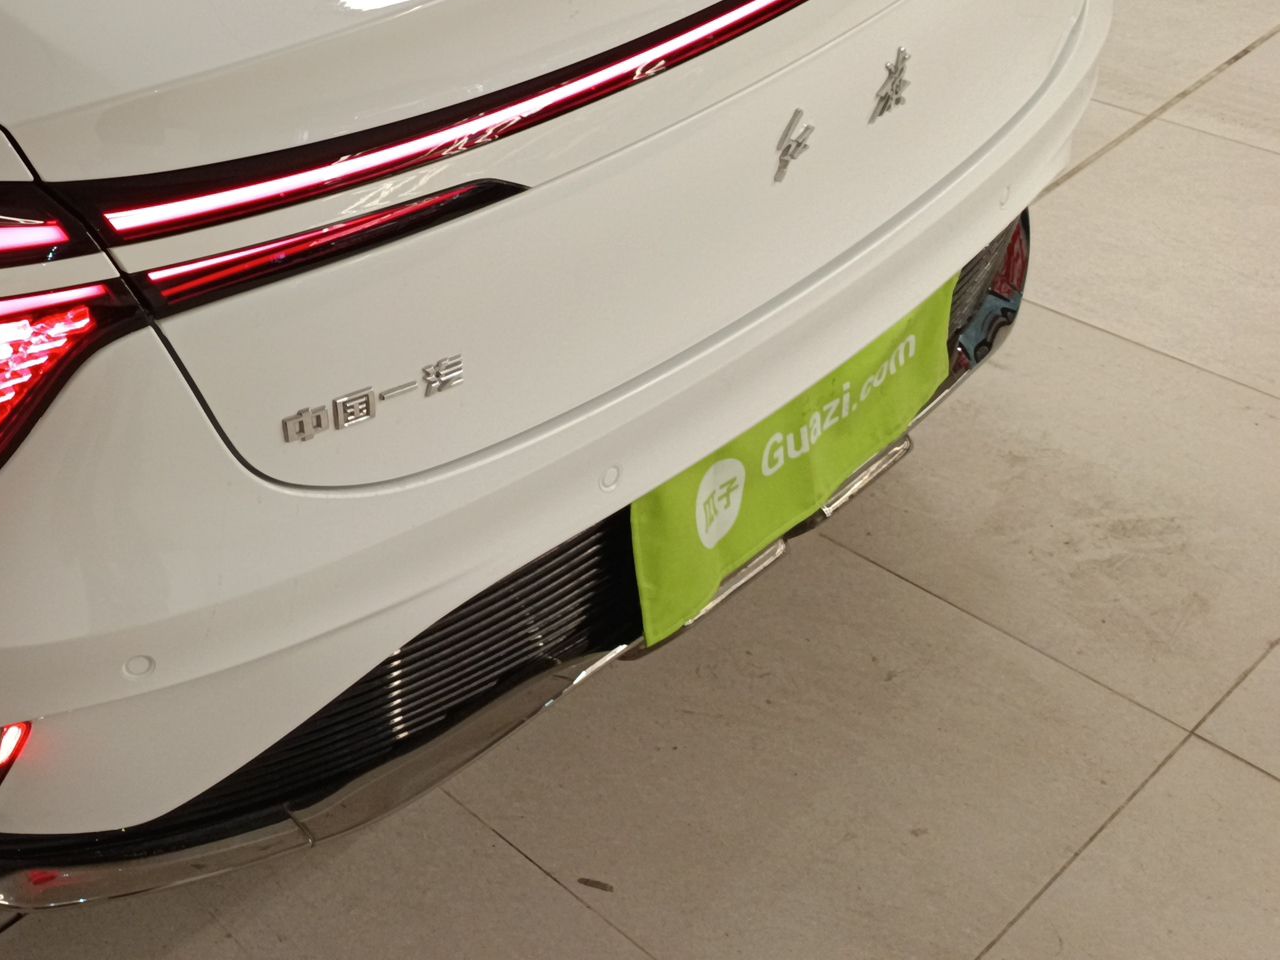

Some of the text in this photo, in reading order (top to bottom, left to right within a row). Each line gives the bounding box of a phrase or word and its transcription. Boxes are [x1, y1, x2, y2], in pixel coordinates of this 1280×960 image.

[282, 353, 464, 443] 中国一汽
[761, 334, 916, 477] Guazi.com
[702, 477, 739, 534] 瓜子
